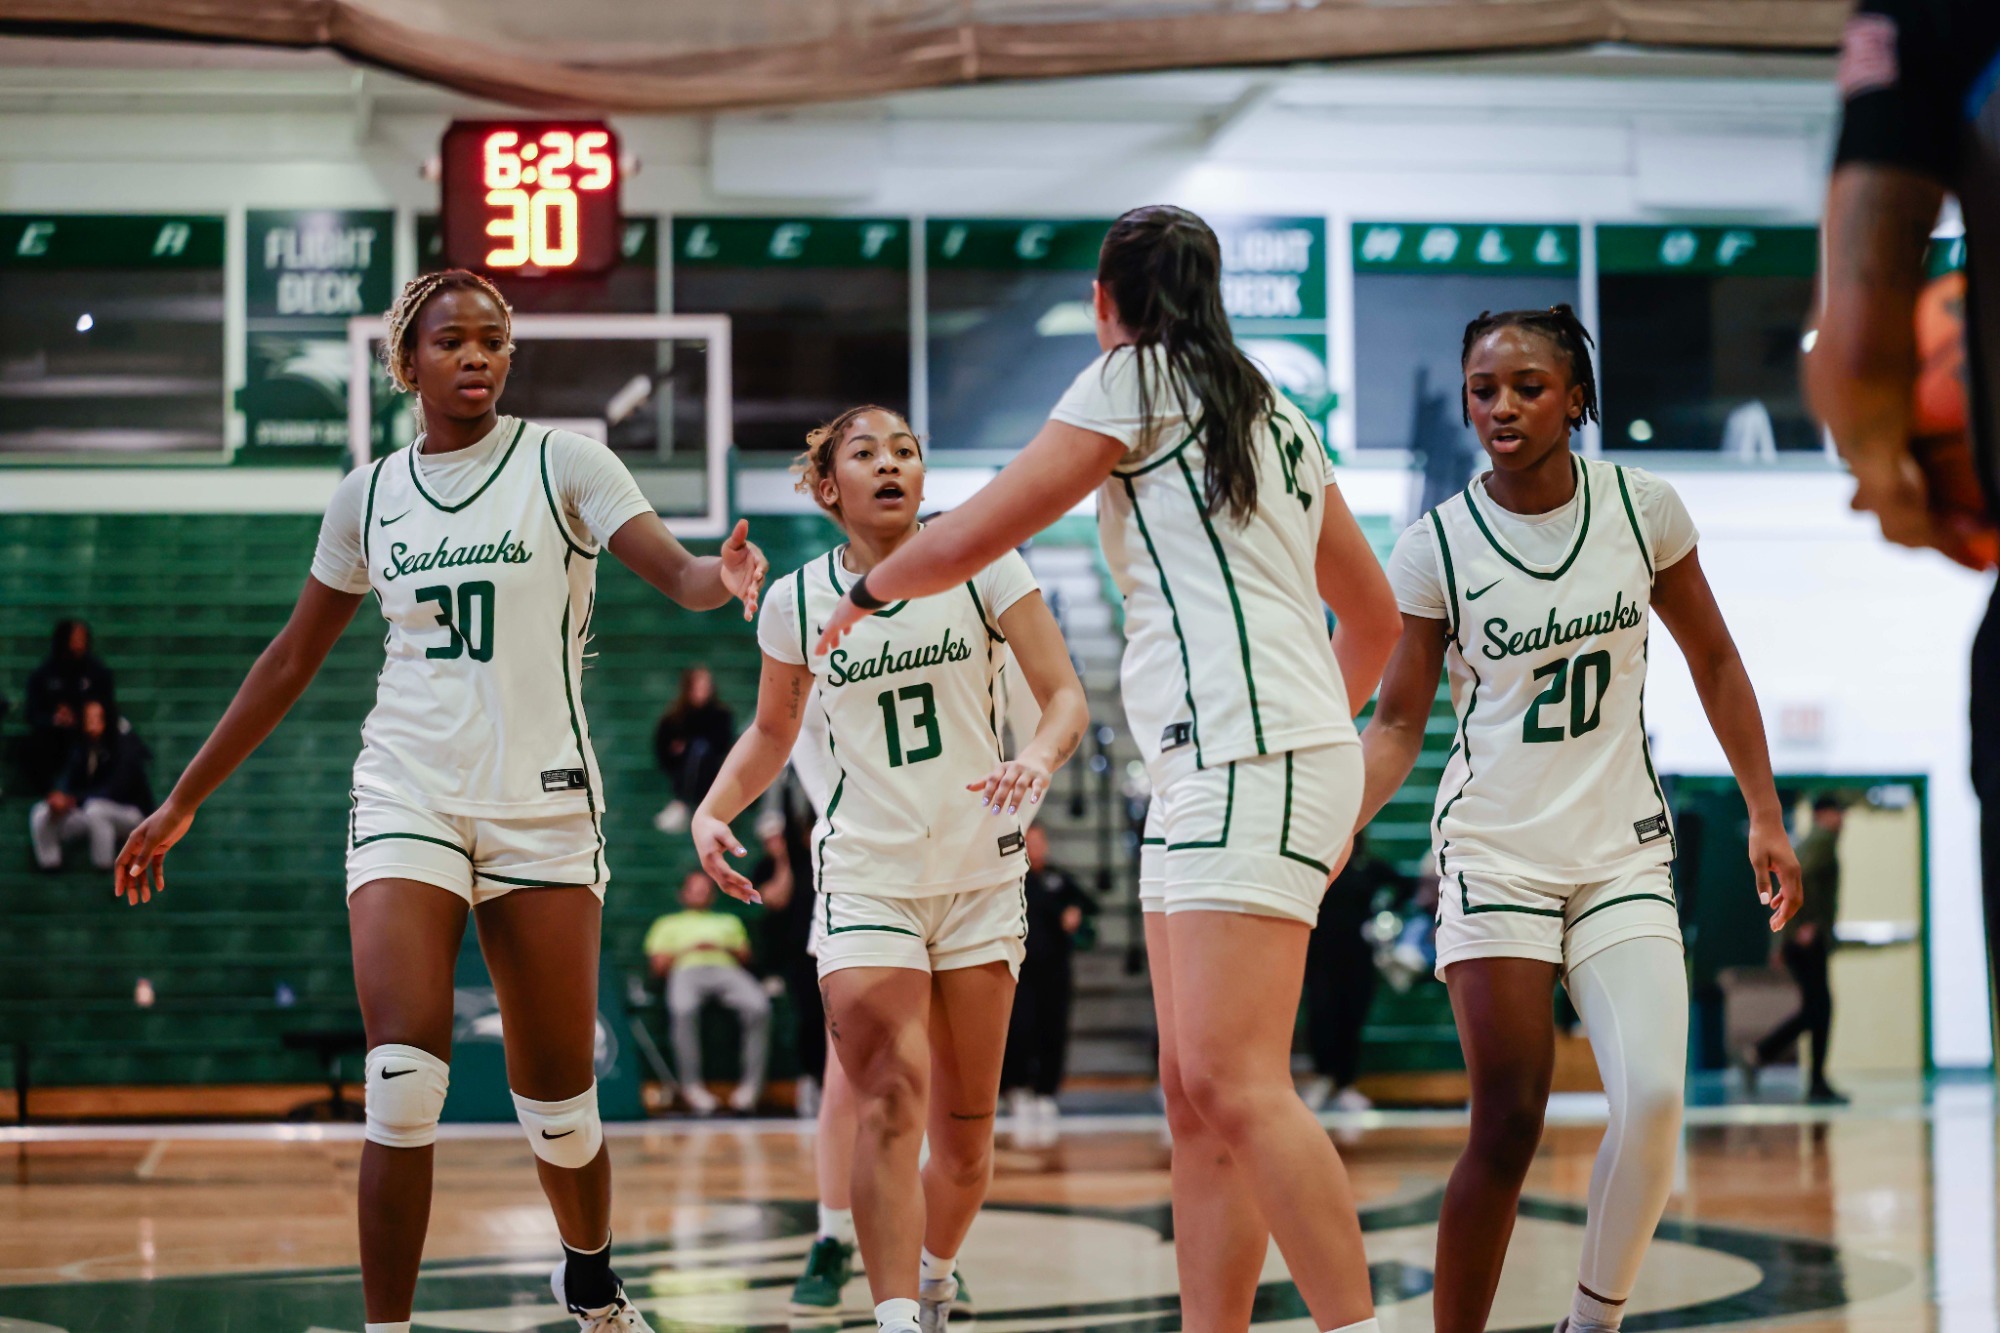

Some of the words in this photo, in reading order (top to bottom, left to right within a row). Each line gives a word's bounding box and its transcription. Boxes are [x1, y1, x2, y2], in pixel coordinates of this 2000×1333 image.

[484, 131, 612, 190] 6:25
[264, 227, 376, 270] FLIGHT
[485, 188, 578, 267] 30
[1221, 229, 1313, 272] LIGHT
[277, 272, 363, 314] DECK
[384, 529, 533, 581] Seahawks
[415, 580, 495, 663] 30
[1482, 591, 1642, 660] Seahawks
[827, 628, 971, 687] Seahawks
[878, 682, 942, 768] 13
[1522, 650, 1611, 743] 20
